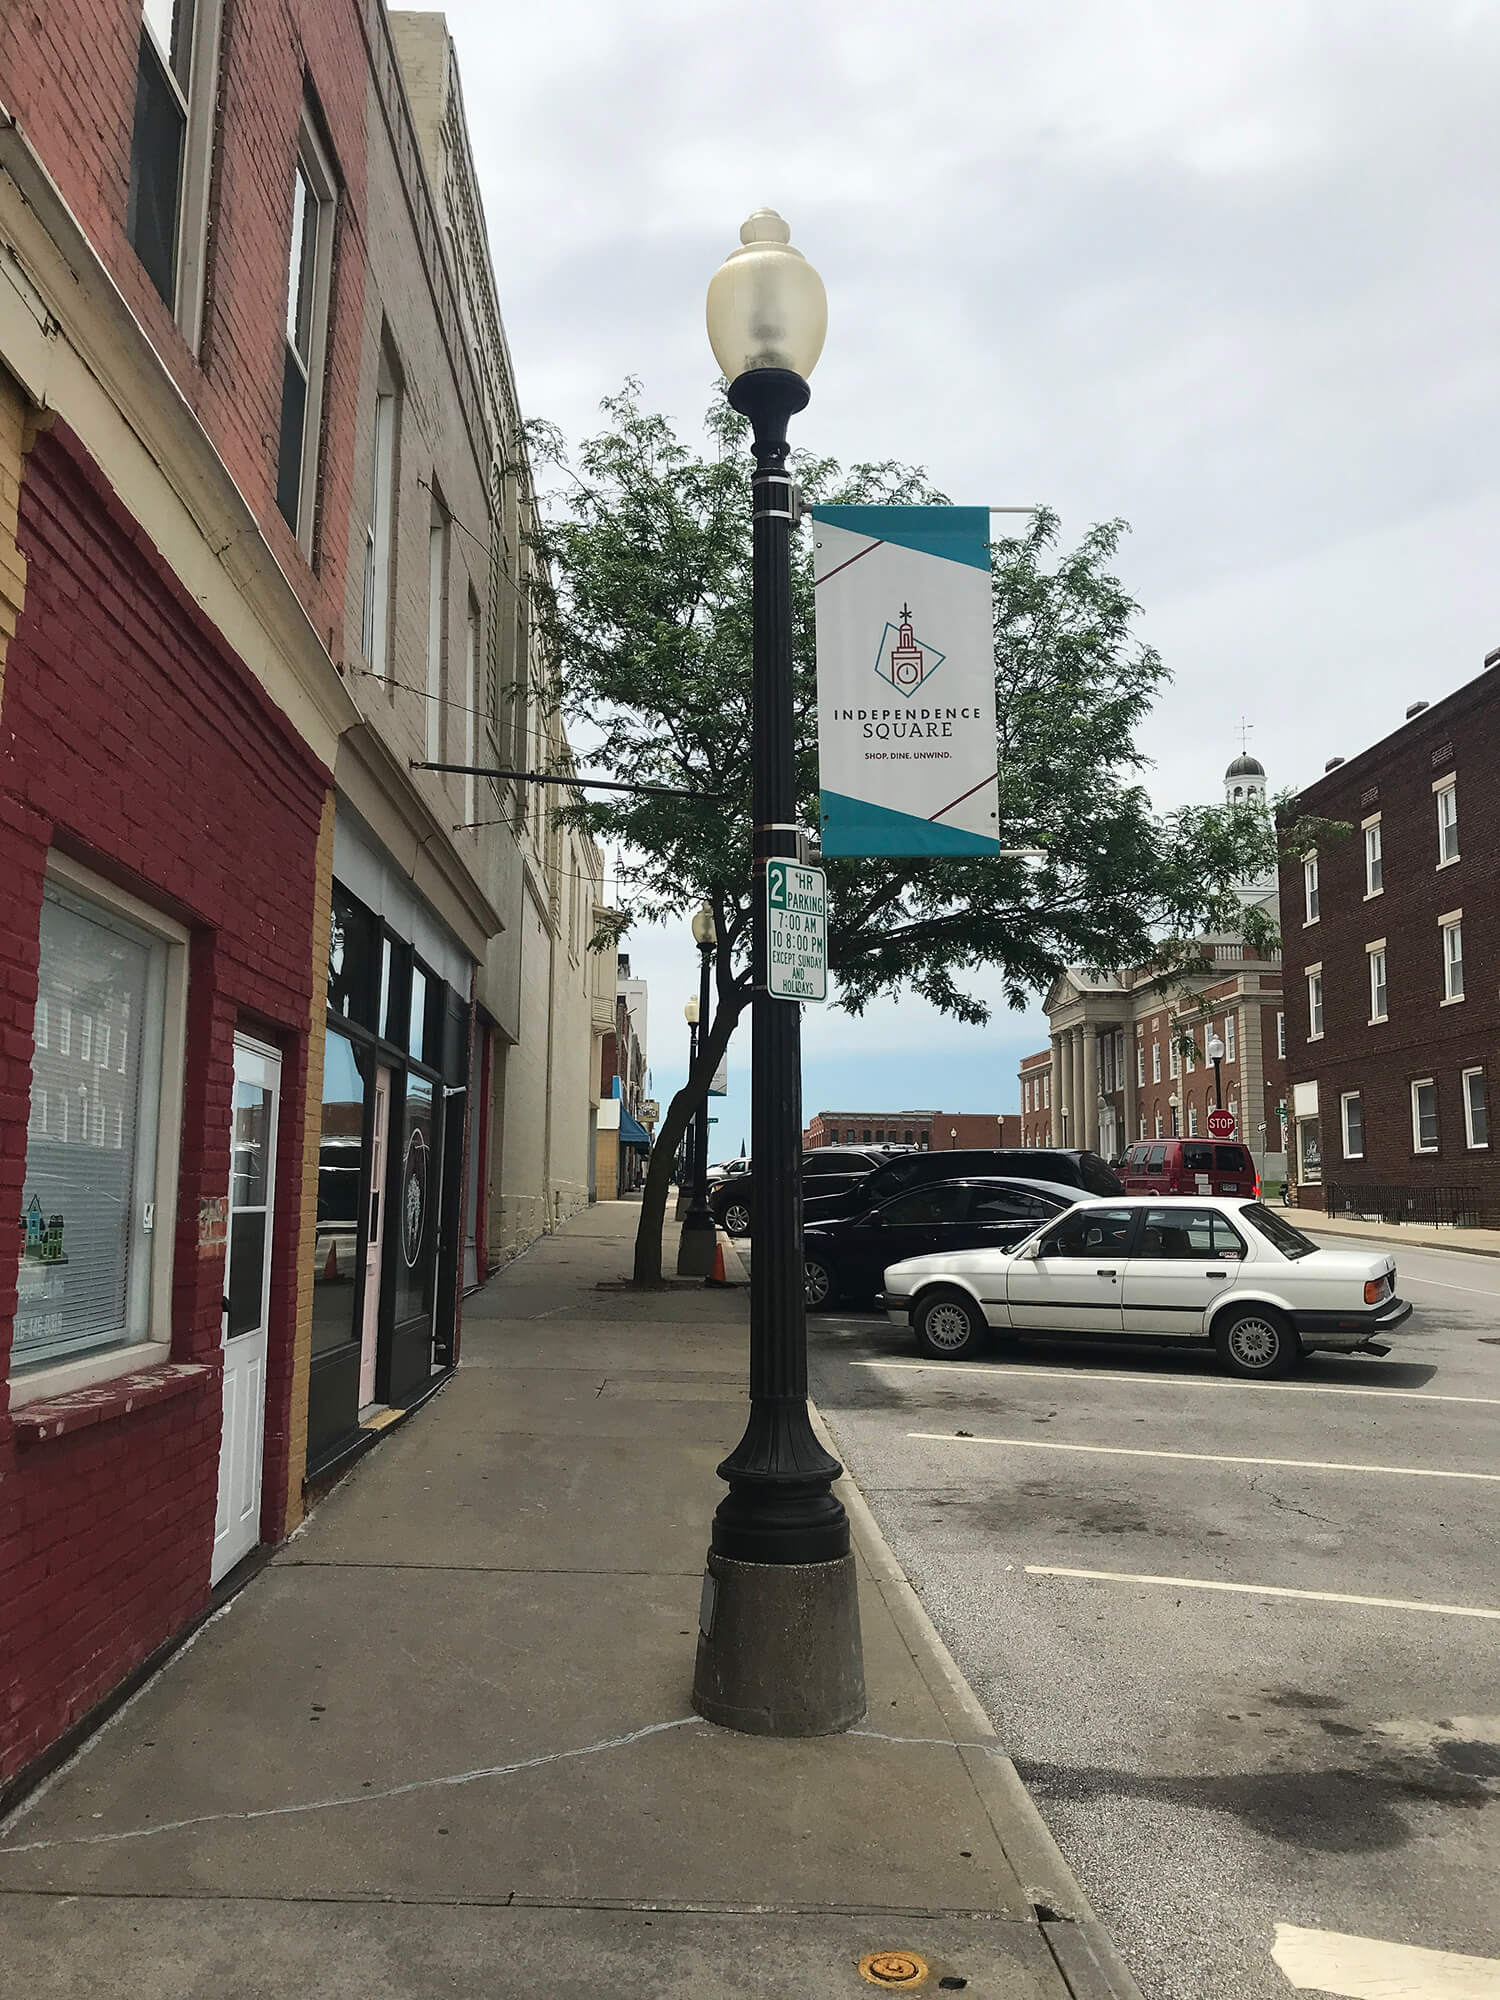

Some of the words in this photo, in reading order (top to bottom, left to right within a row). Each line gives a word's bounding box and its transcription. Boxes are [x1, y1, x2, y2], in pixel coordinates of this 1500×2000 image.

[834, 708, 980, 720] INDEPENDENCE
[863, 722, 952, 740] SQUARE
[865, 752, 888, 760] SHOP.
[890, 752, 912, 760] DINE.
[914, 751, 952, 760] UNWIND.
[771, 869, 784, 902] 2
[799, 873, 813, 891] HR
[787, 891, 823, 914] PARKING
[779, 911, 801, 931] 7:00
[805, 916, 817, 934] AM
[772, 930, 783, 948] TO
[786, 933, 808, 952] 8:00
[812, 936, 823, 954] PM
[772, 950, 796, 966] EXCEPT
[798, 954, 823, 969] SUNDAY
[792, 967, 805, 981] AND
[783, 980, 814, 995] HOLIDAYS
[1209, 1118, 1234, 1129] STOP
